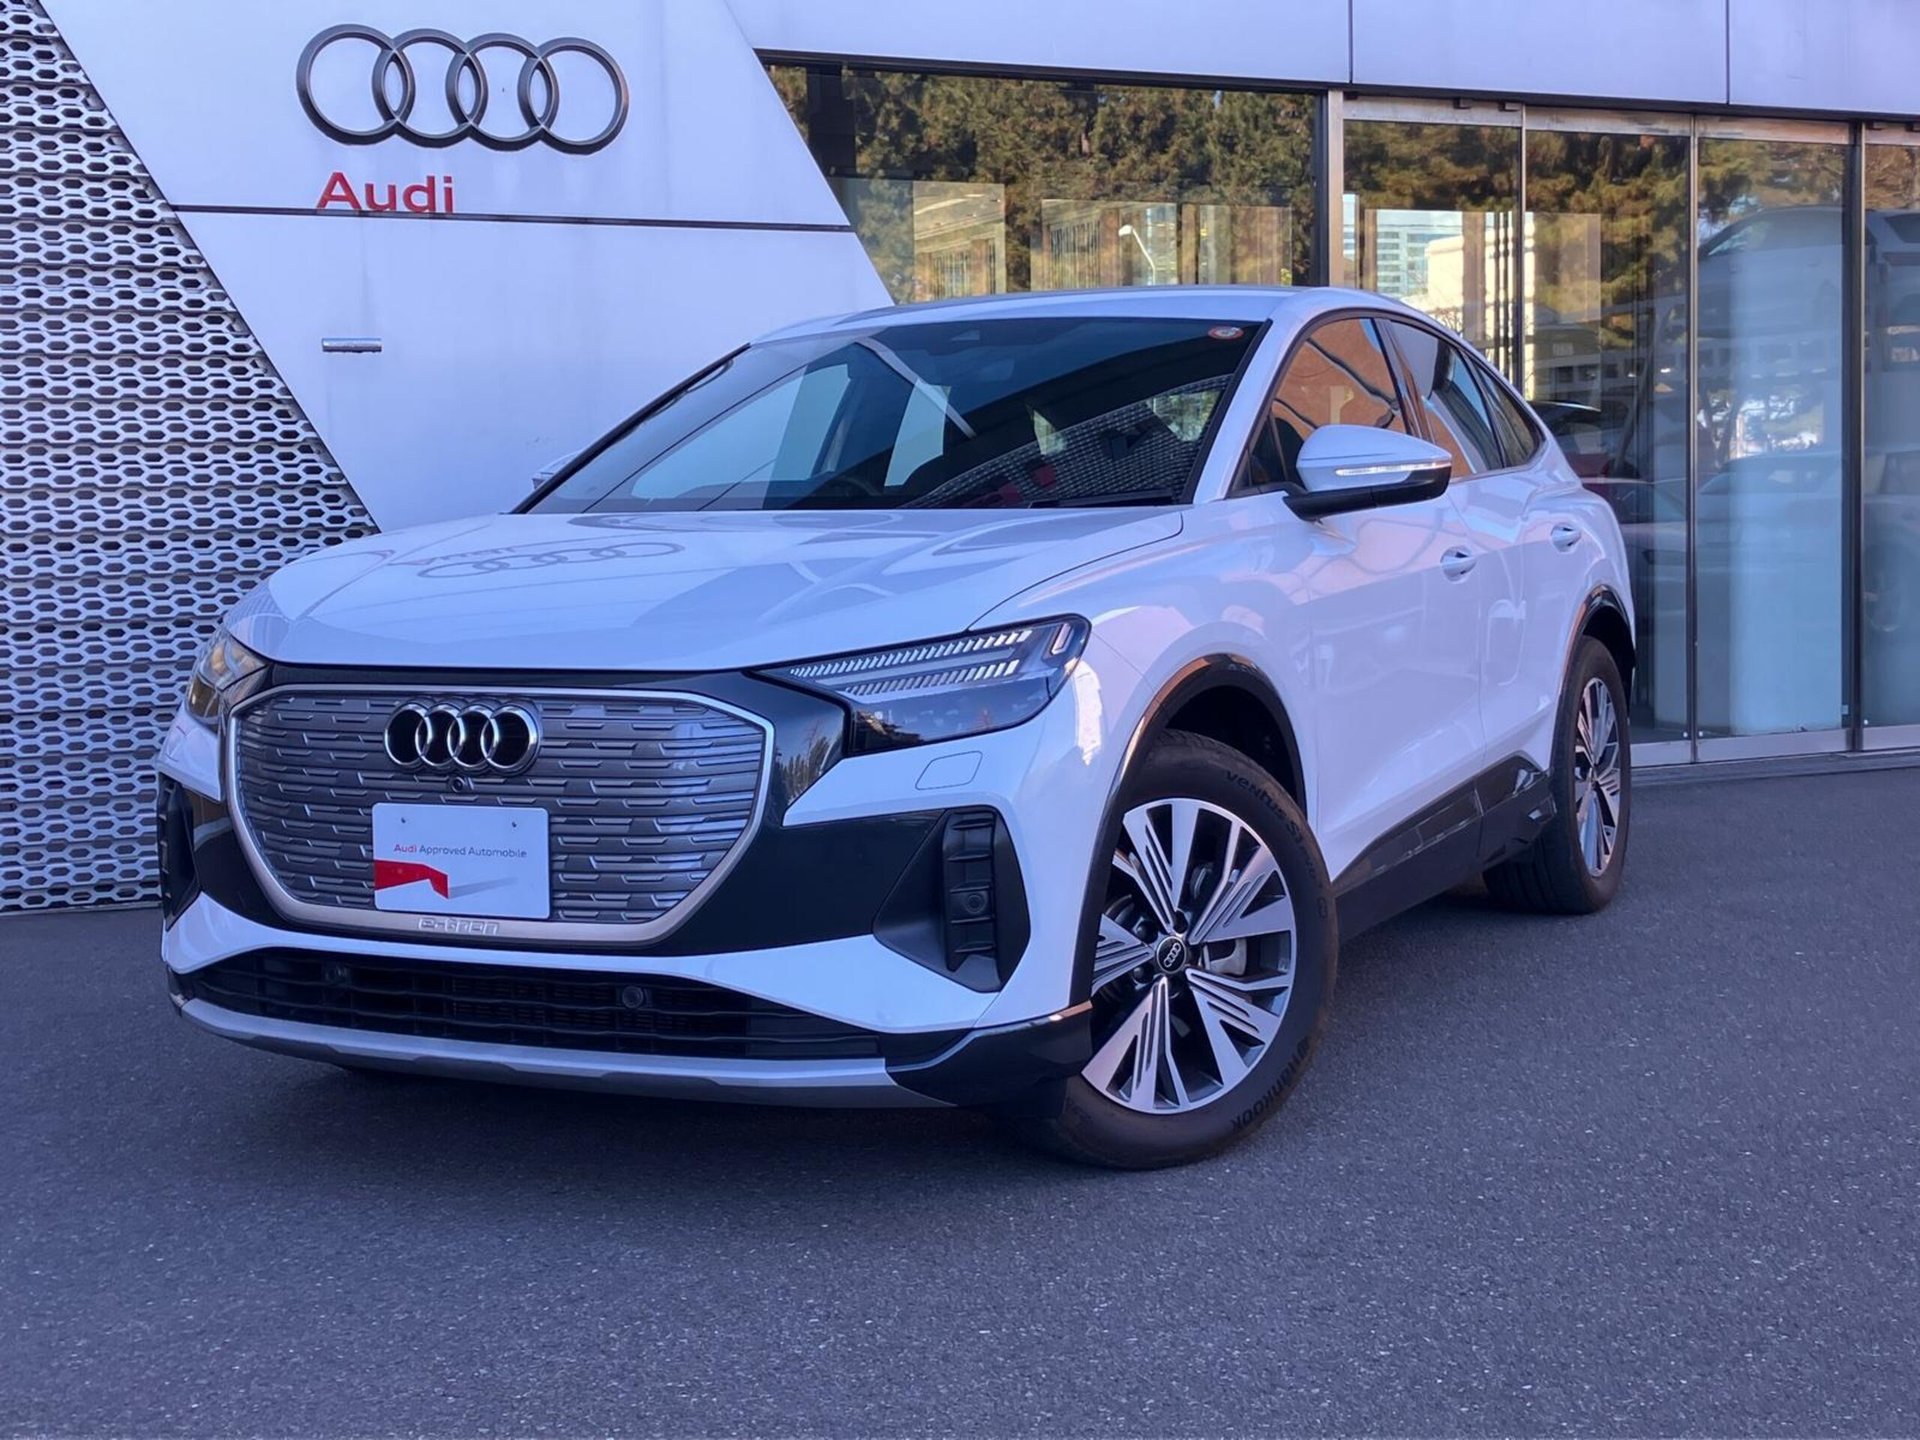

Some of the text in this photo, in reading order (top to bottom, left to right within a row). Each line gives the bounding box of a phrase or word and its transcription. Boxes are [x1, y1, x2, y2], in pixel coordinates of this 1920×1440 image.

[316, 171, 454, 214] Audi
[394, 844, 528, 859] Audi Approved Automobile
